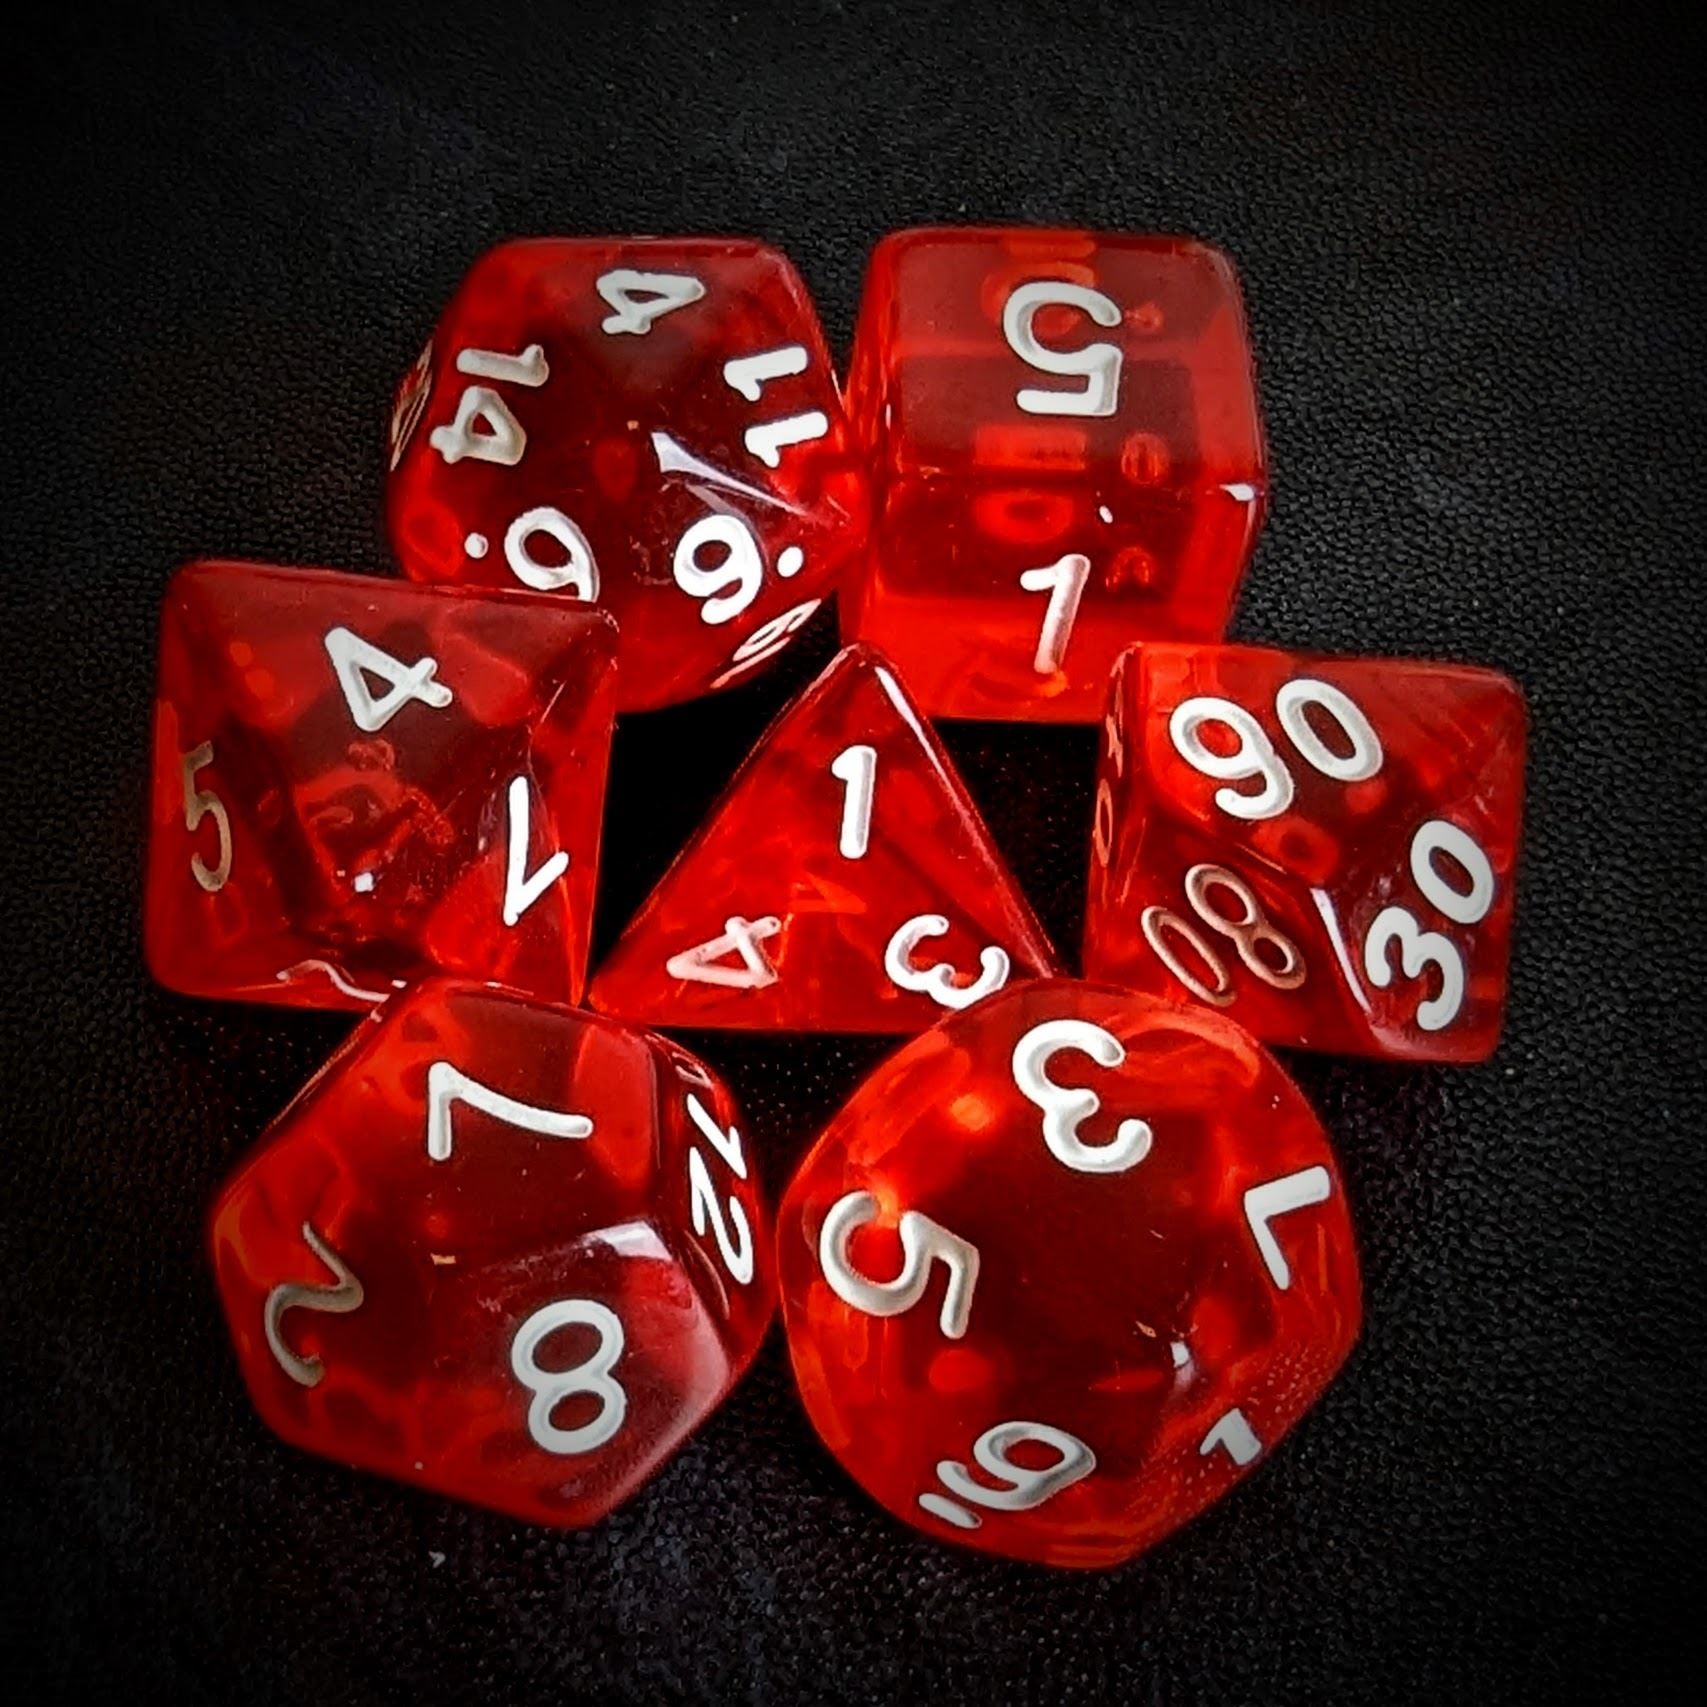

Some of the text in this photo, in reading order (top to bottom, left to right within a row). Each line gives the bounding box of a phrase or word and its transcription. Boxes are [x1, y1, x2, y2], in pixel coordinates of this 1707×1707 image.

[597, 269, 705, 335] 4
[1003, 281, 1122, 416] 5
[430, 344, 550, 465] 14
[724, 346, 828, 467] 11
[325, 627, 453, 732] 4
[1020, 553, 1090, 674] 1
[183, 740, 232, 892] 5
[831, 745, 877, 859] 1
[1169, 679, 1384, 820] 90
[503, 776, 570, 926] 1
[666, 916, 782, 989] 4
[885, 915, 1010, 1010] 3
[1140, 864, 1306, 1007] 80
[1364, 820, 1495, 1031] 30
[427, 1062, 593, 1161] 7
[1012, 1019, 1153, 1173] 3
[687, 1093, 754, 1284] 12
[265, 1221, 364, 1387] 2
[819, 1190, 981, 1339] 5
[511, 1298, 628, 1454] 8
